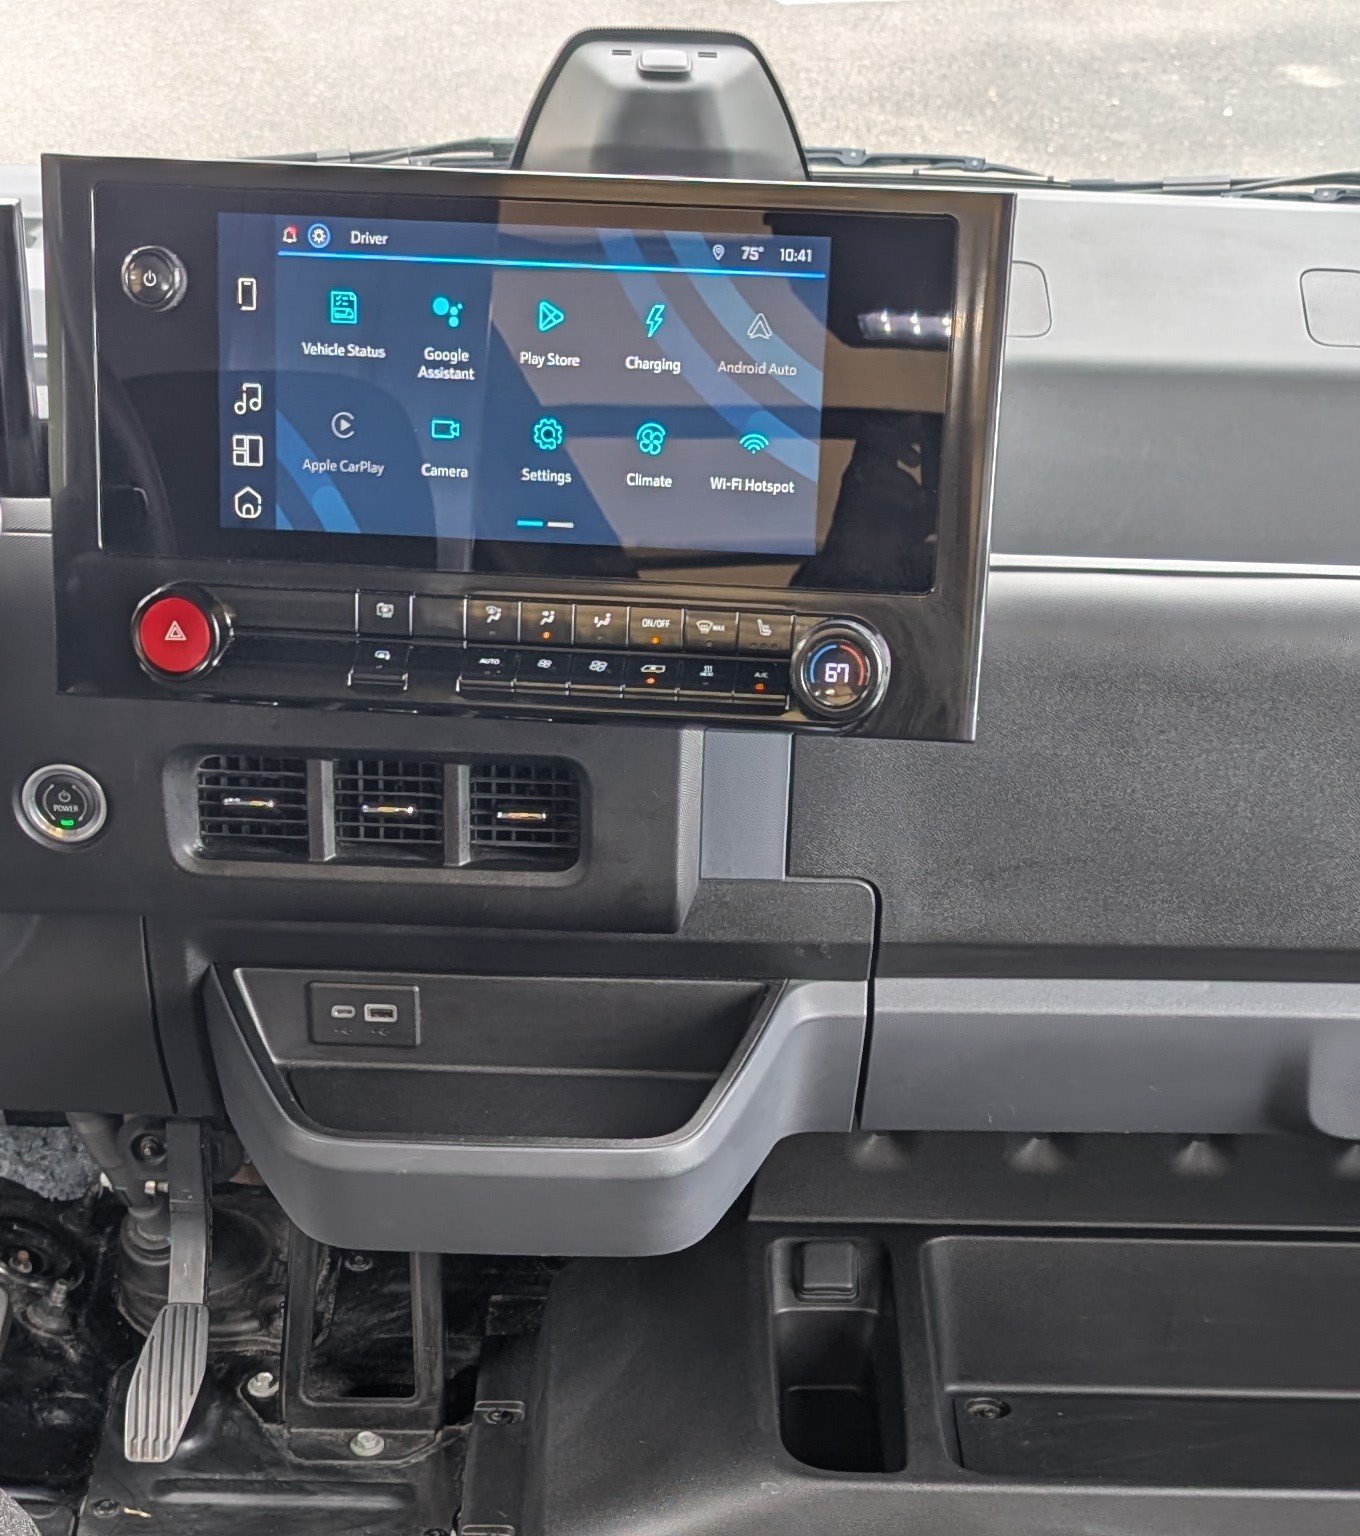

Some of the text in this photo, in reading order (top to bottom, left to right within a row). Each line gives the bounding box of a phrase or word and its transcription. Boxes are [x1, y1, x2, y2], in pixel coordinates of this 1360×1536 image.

[350, 230, 389, 245] Driver
[779, 247, 813, 263] 10:41
[301, 341, 387, 359] Vehicle Status
[423, 346, 470, 364] Google
[519, 351, 581, 367] Play Store
[625, 356, 682, 375] Charging
[417, 365, 475, 381] Assistant
[717, 360, 797, 376] Android Auto
[301, 458, 386, 477] Apple CarPlay
[421, 463, 469, 478] Camera
[520, 467, 572, 486] Settings
[625, 472, 673, 488] Climate
[709, 476, 795, 496] Wi-Fi Hotspot
[641, 618, 671, 629] ON/OFF
[824, 663, 850, 683] 67
[53, 804, 79, 813] POWER
